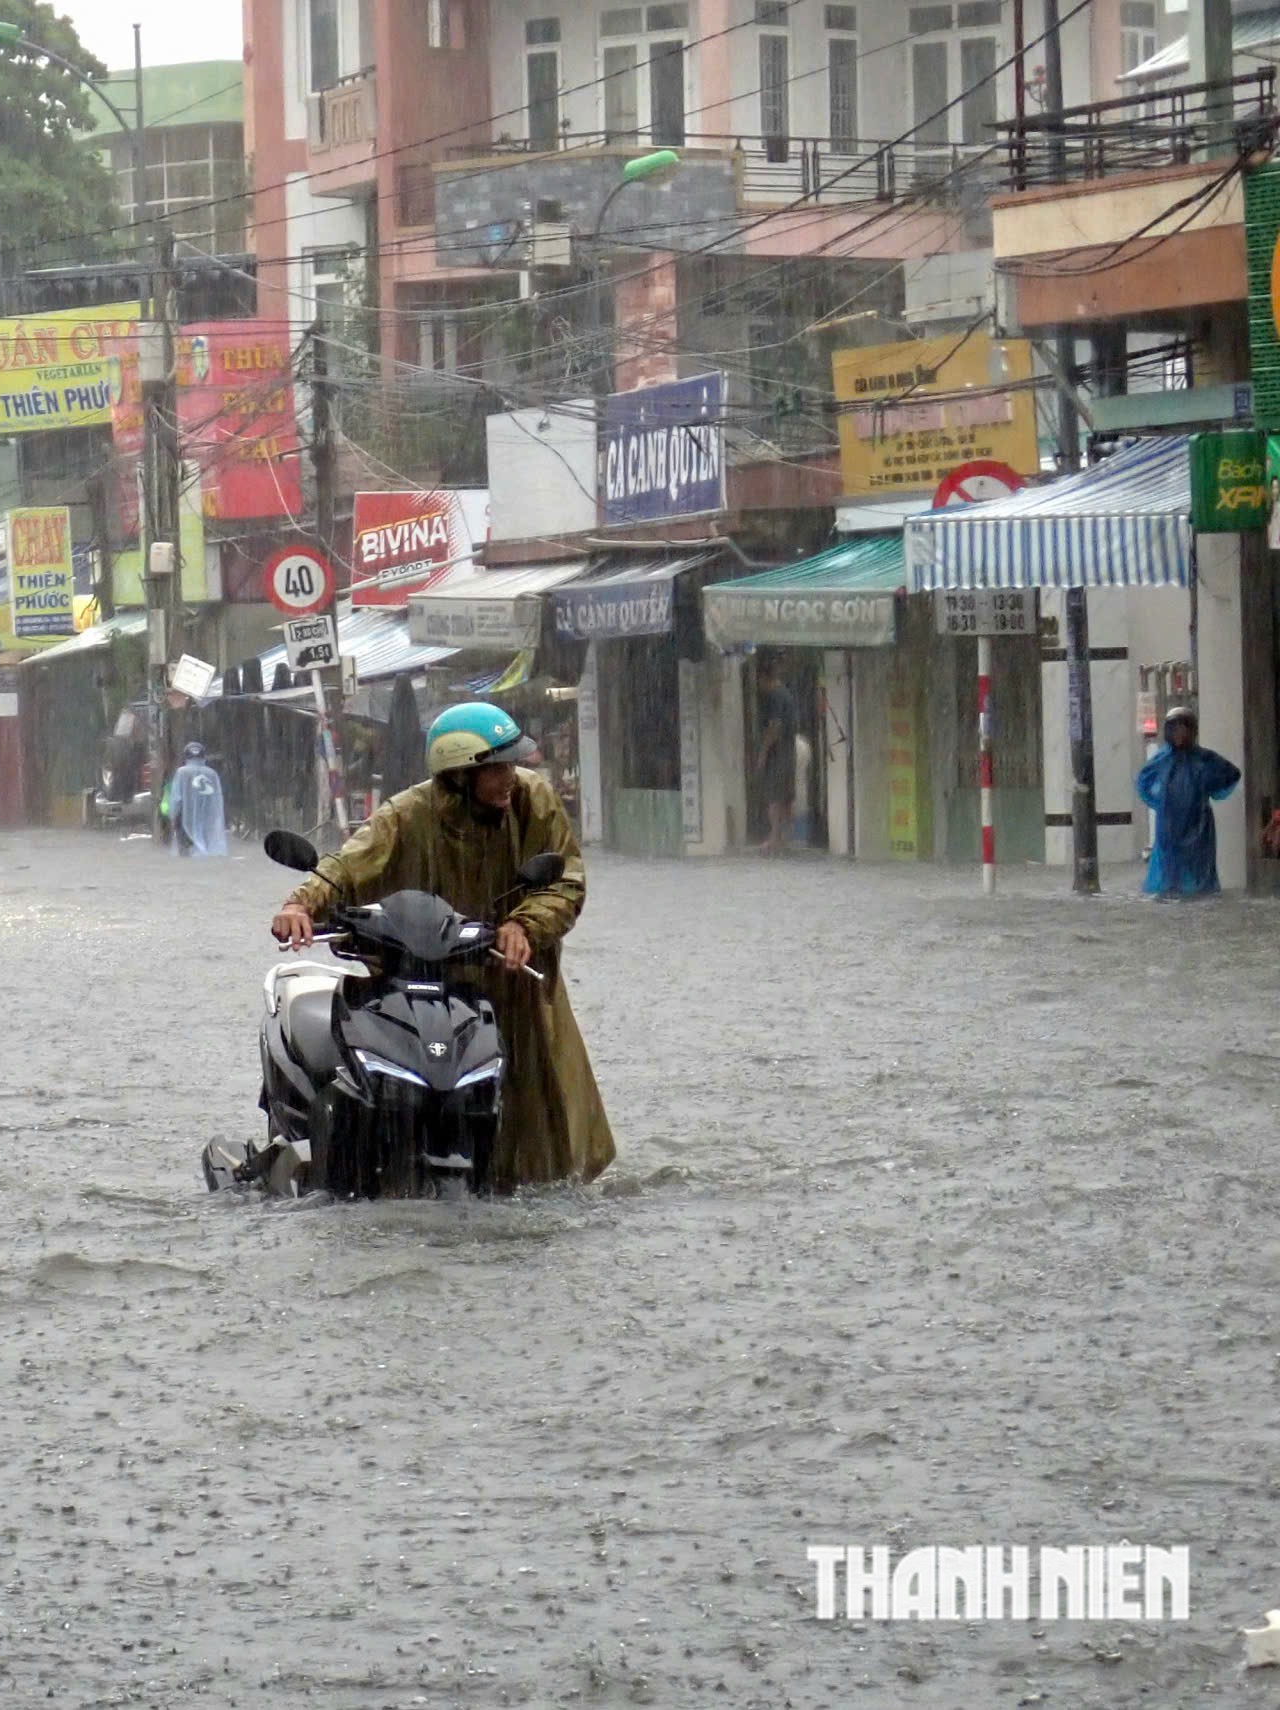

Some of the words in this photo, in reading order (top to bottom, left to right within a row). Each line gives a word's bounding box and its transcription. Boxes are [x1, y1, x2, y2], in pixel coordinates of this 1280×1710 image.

[36, 364, 103, 380] VEGETARIAN
[0, 385, 60, 419] THIÊN
[361, 515, 449, 563] BIVINA
[17, 571, 66, 589] THIÊN
[285, 565, 314, 598] 40
[15, 591, 70, 610] PHƯỚC
